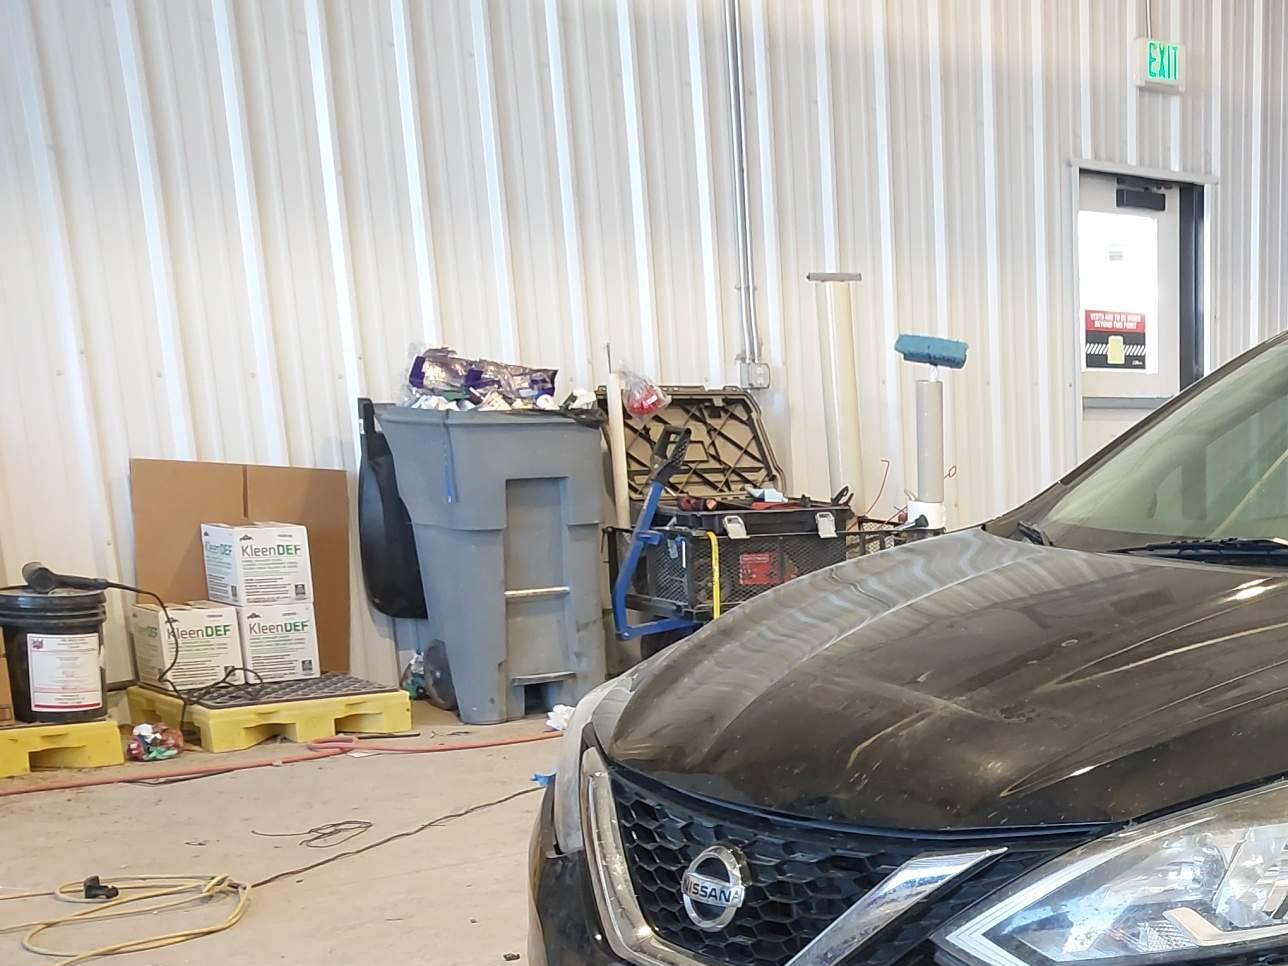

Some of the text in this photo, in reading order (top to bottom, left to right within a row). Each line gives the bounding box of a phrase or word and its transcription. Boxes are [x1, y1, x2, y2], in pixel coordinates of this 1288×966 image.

[1148, 42, 1178, 80] EXIT
[241, 543, 302, 557] KleenDEF
[167, 624, 232, 640] KleenDEF
[248, 620, 309, 635] KleenDEF
[686, 877, 732, 903] NISSAN
